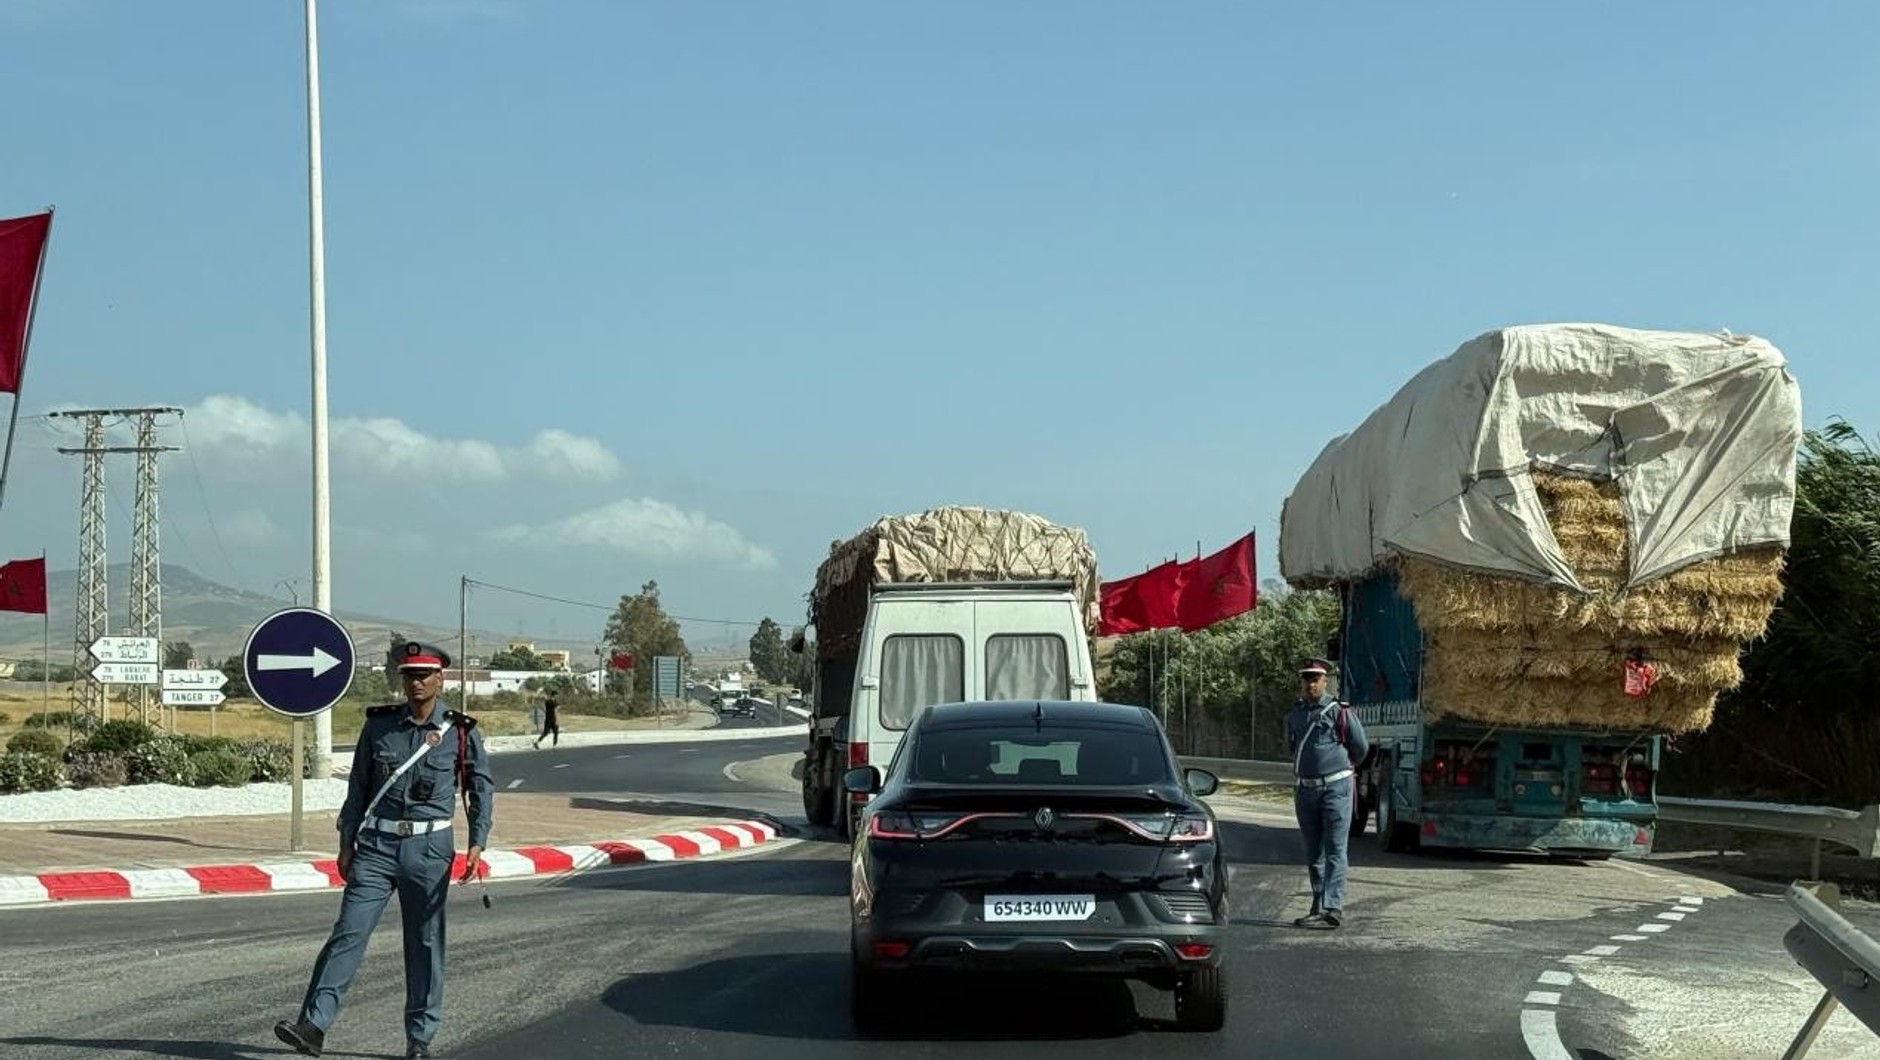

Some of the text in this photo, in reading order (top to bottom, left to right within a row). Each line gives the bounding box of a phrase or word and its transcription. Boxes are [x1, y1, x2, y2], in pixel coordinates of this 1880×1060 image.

[119, 650, 148, 662] الرباط
[169, 673, 220, 686] طنجة 27
[171, 692, 220, 702] TANGER 27
[993, 901, 1088, 916] 654340 WW
